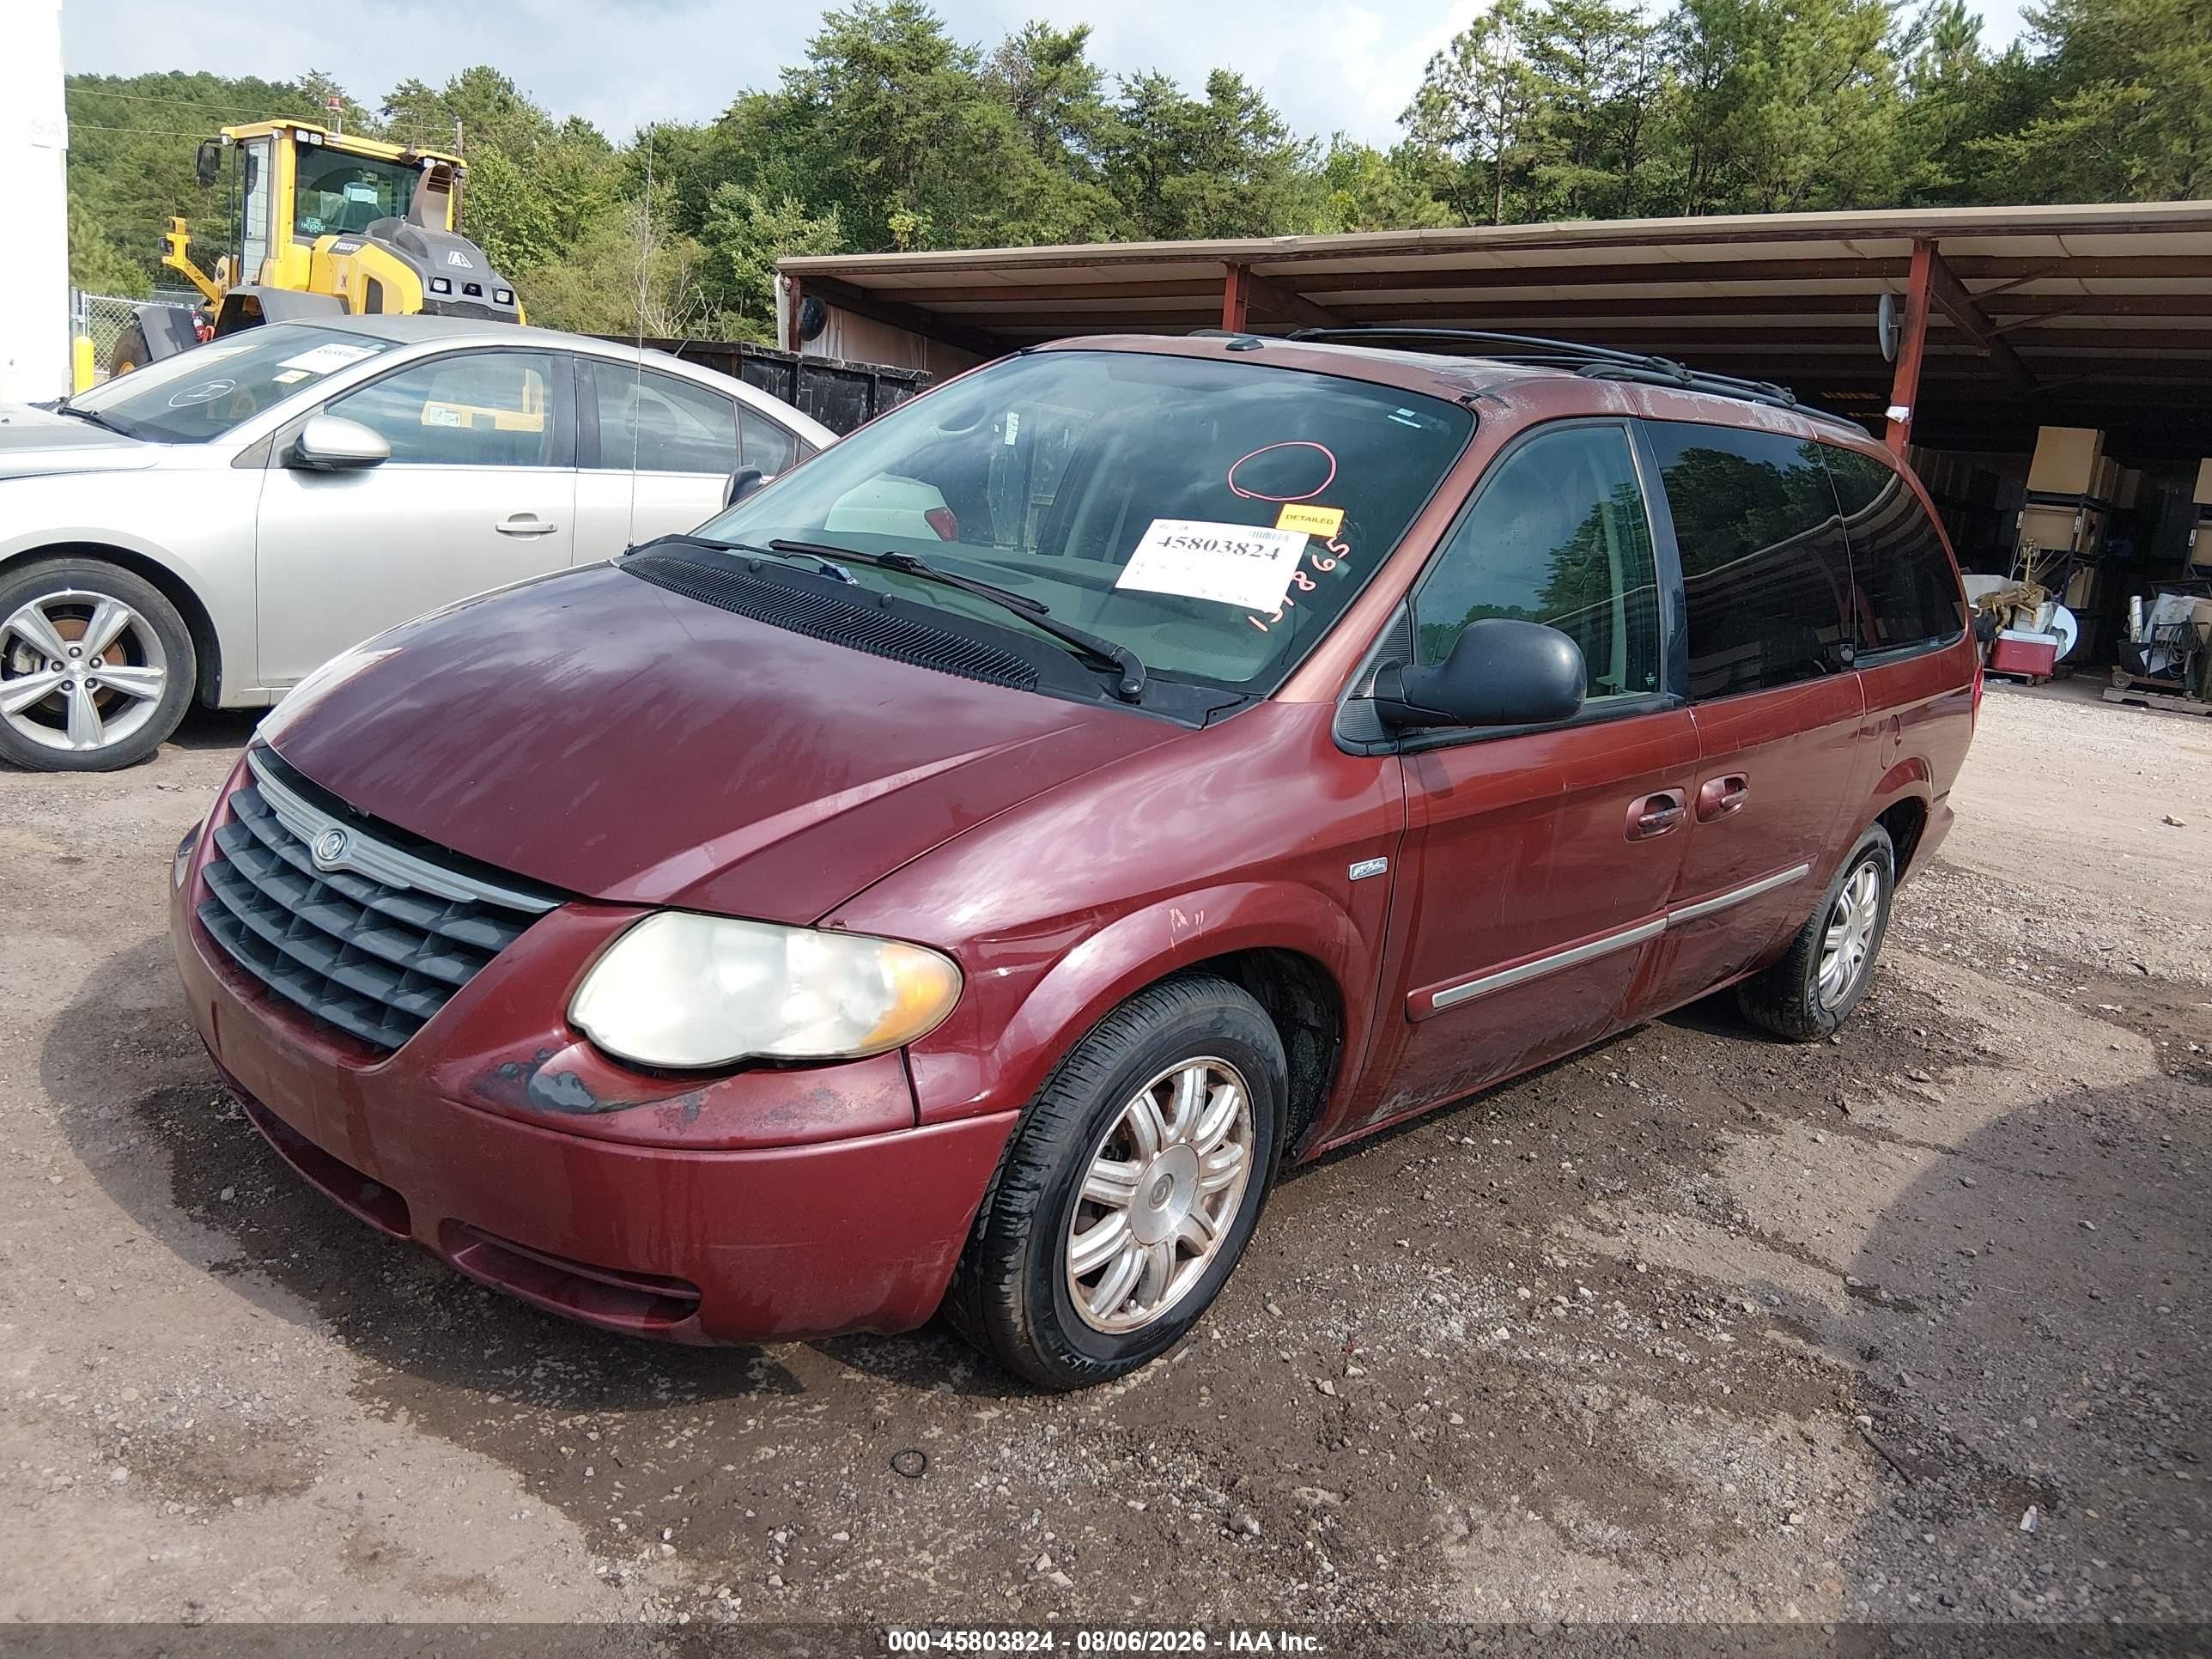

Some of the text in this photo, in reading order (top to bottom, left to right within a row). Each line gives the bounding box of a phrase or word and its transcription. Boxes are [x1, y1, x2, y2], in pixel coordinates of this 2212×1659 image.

[334, 241, 362, 252] VOLVO
[1285, 514, 1334, 526] DETAILED
[1157, 534, 1281, 560] 45803824
